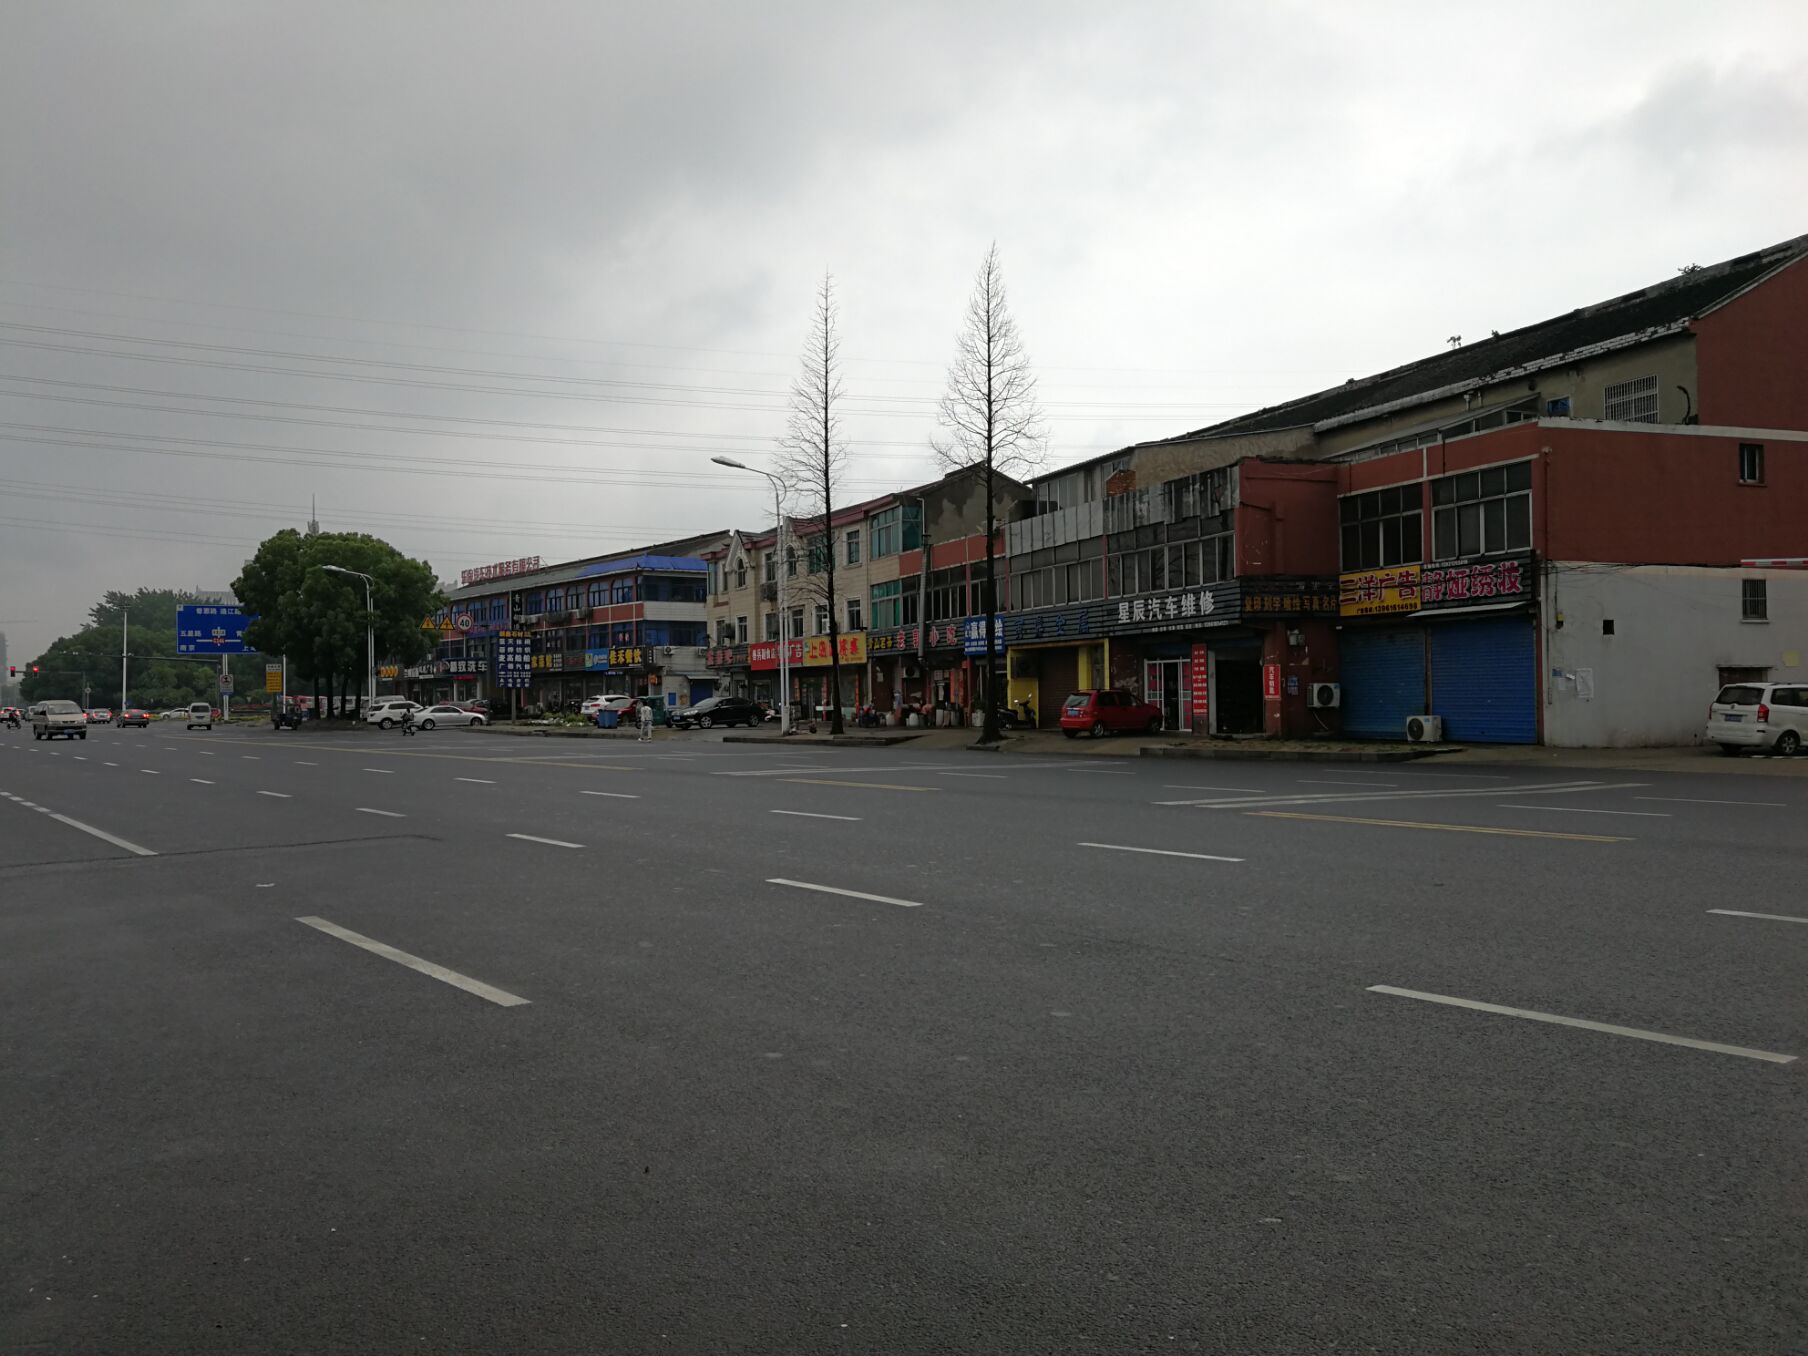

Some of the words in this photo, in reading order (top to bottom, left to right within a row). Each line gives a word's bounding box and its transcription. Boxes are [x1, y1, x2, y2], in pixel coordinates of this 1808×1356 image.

[1340, 570, 1418, 605] 三洋广告
[460, 619, 470, 628] 40
[1118, 590, 1215, 624] 星辰汽车维修
